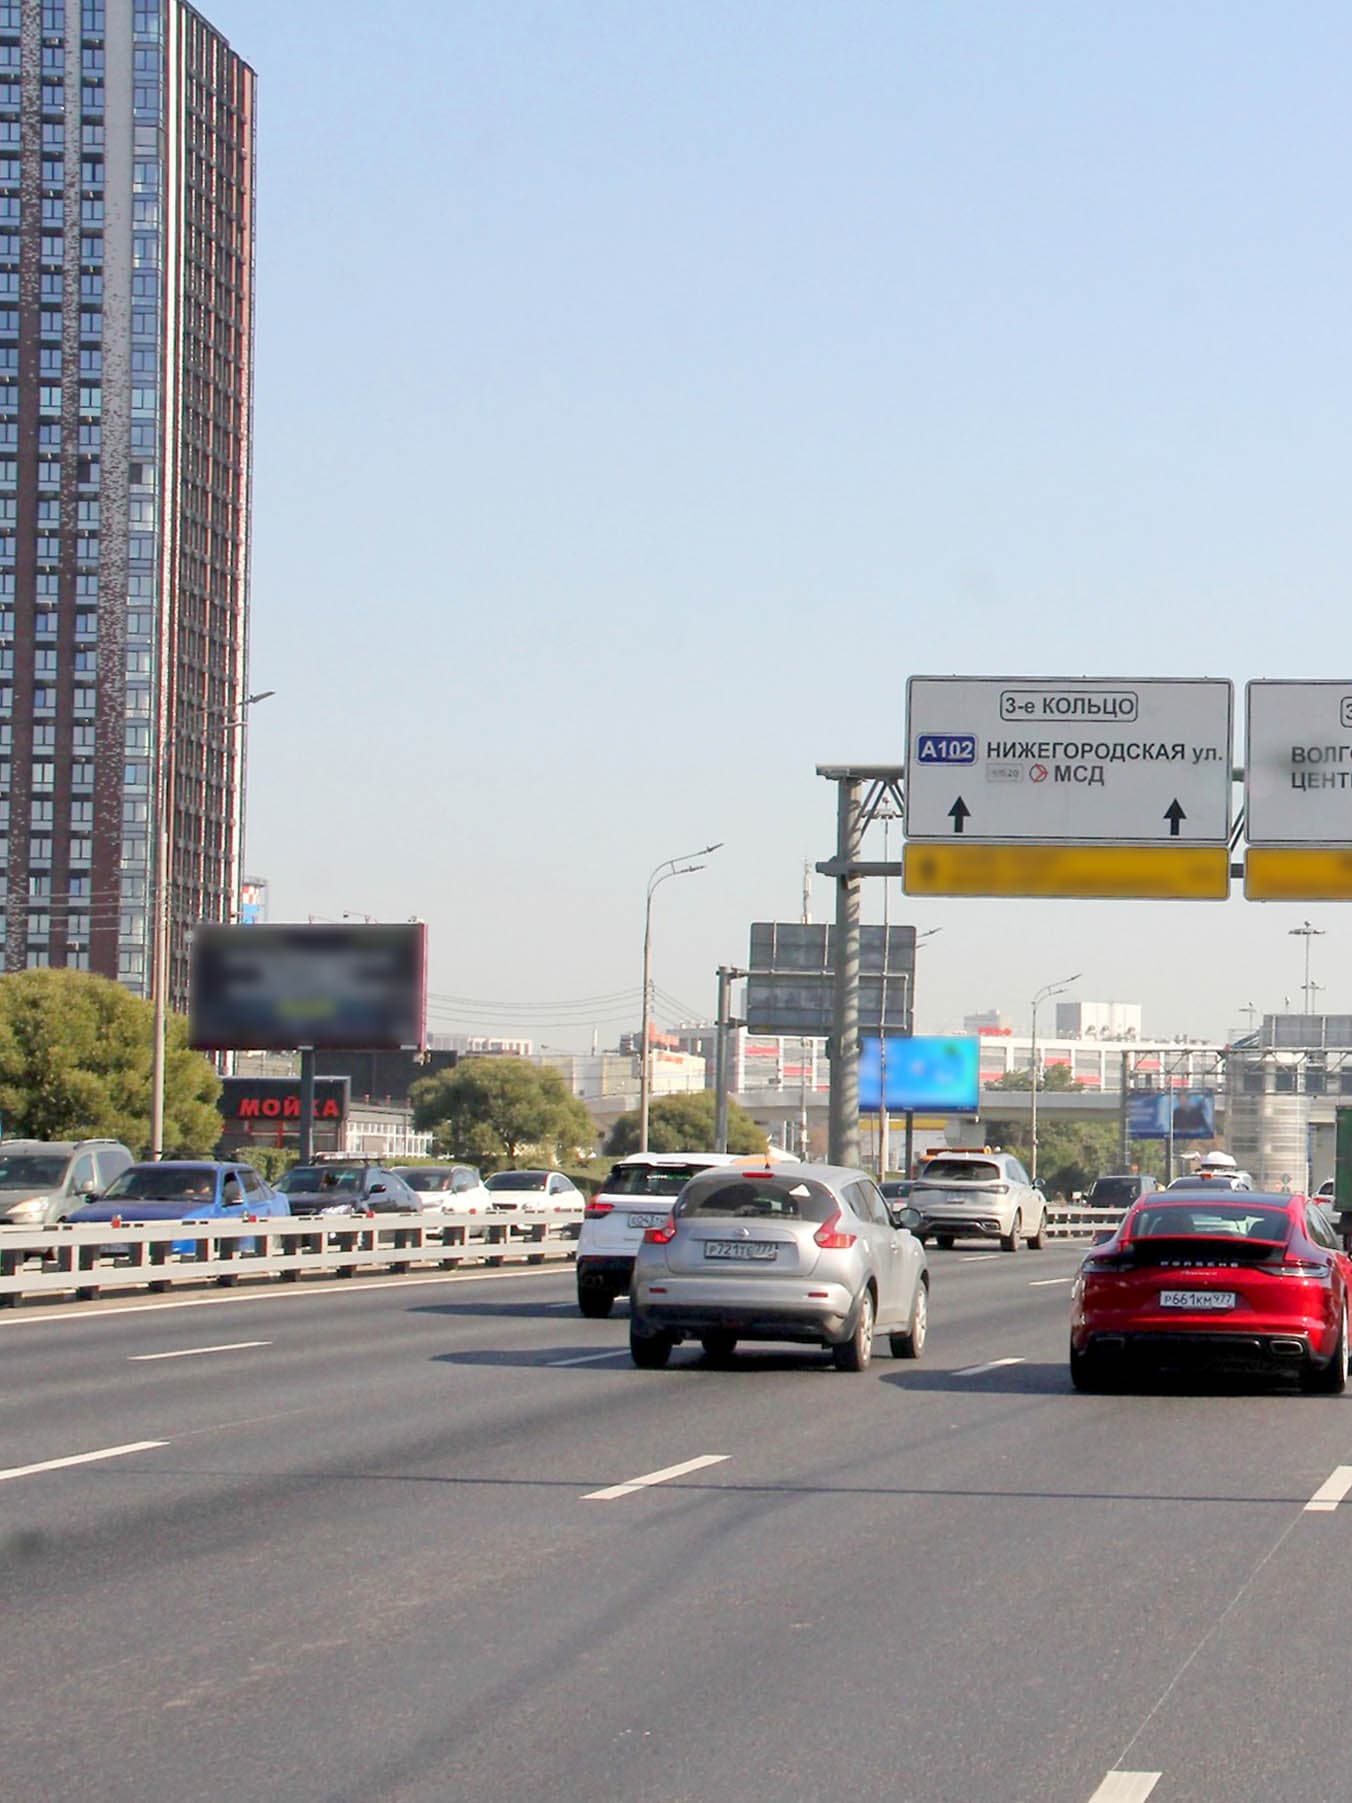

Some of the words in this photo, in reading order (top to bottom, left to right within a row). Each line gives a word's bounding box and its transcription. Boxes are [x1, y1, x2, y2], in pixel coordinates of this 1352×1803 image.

[1005, 698, 1035, 714] 3-е
[1042, 698, 1135, 717] КОЛЬЦО
[986, 741, 1185, 762] НИЖЕГОРОДСКАЯ
[1192, 746, 1224, 765] ул.
[1054, 764, 1105, 786] МСД
